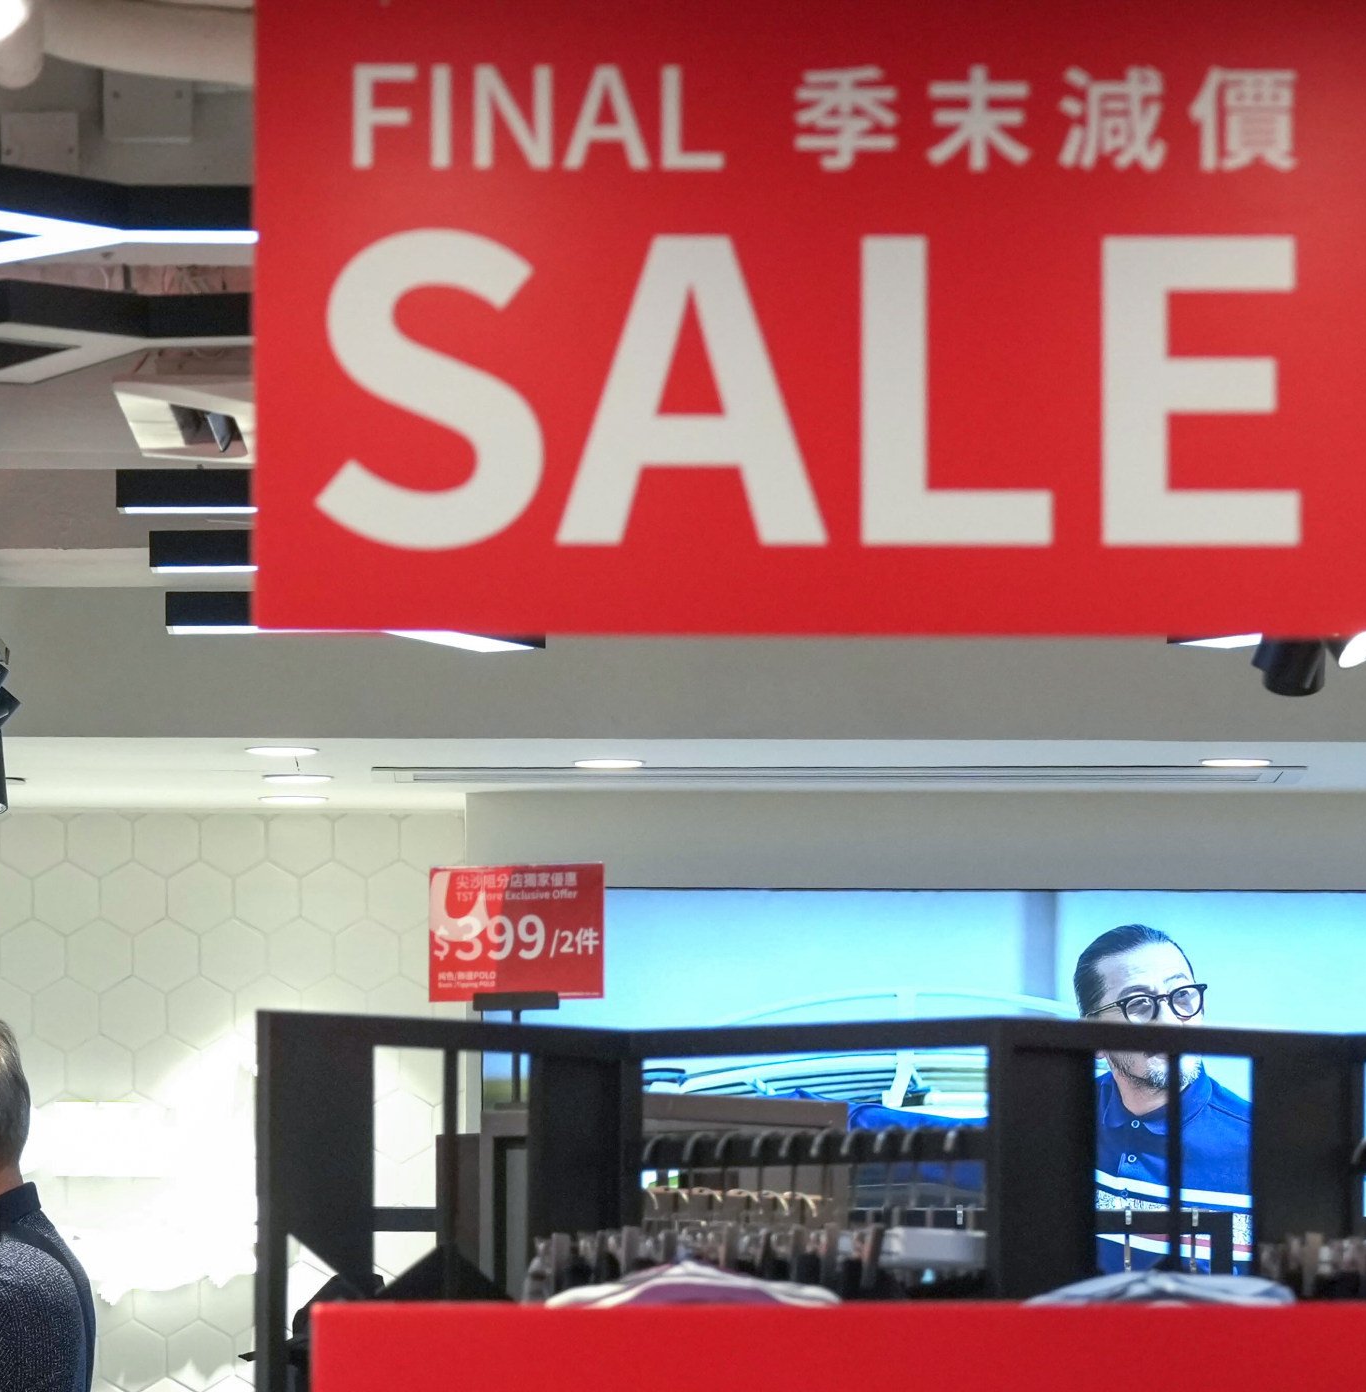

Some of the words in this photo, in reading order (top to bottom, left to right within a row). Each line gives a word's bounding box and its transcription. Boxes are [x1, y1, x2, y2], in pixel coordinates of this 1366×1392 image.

[351, 63, 725, 171] FINAL
[794, 65, 1299, 173] 季末減價
[315, 228, 1301, 551] SALE
[504, 889, 551, 901] Exclusive
[552, 887, 579, 900] Offer
